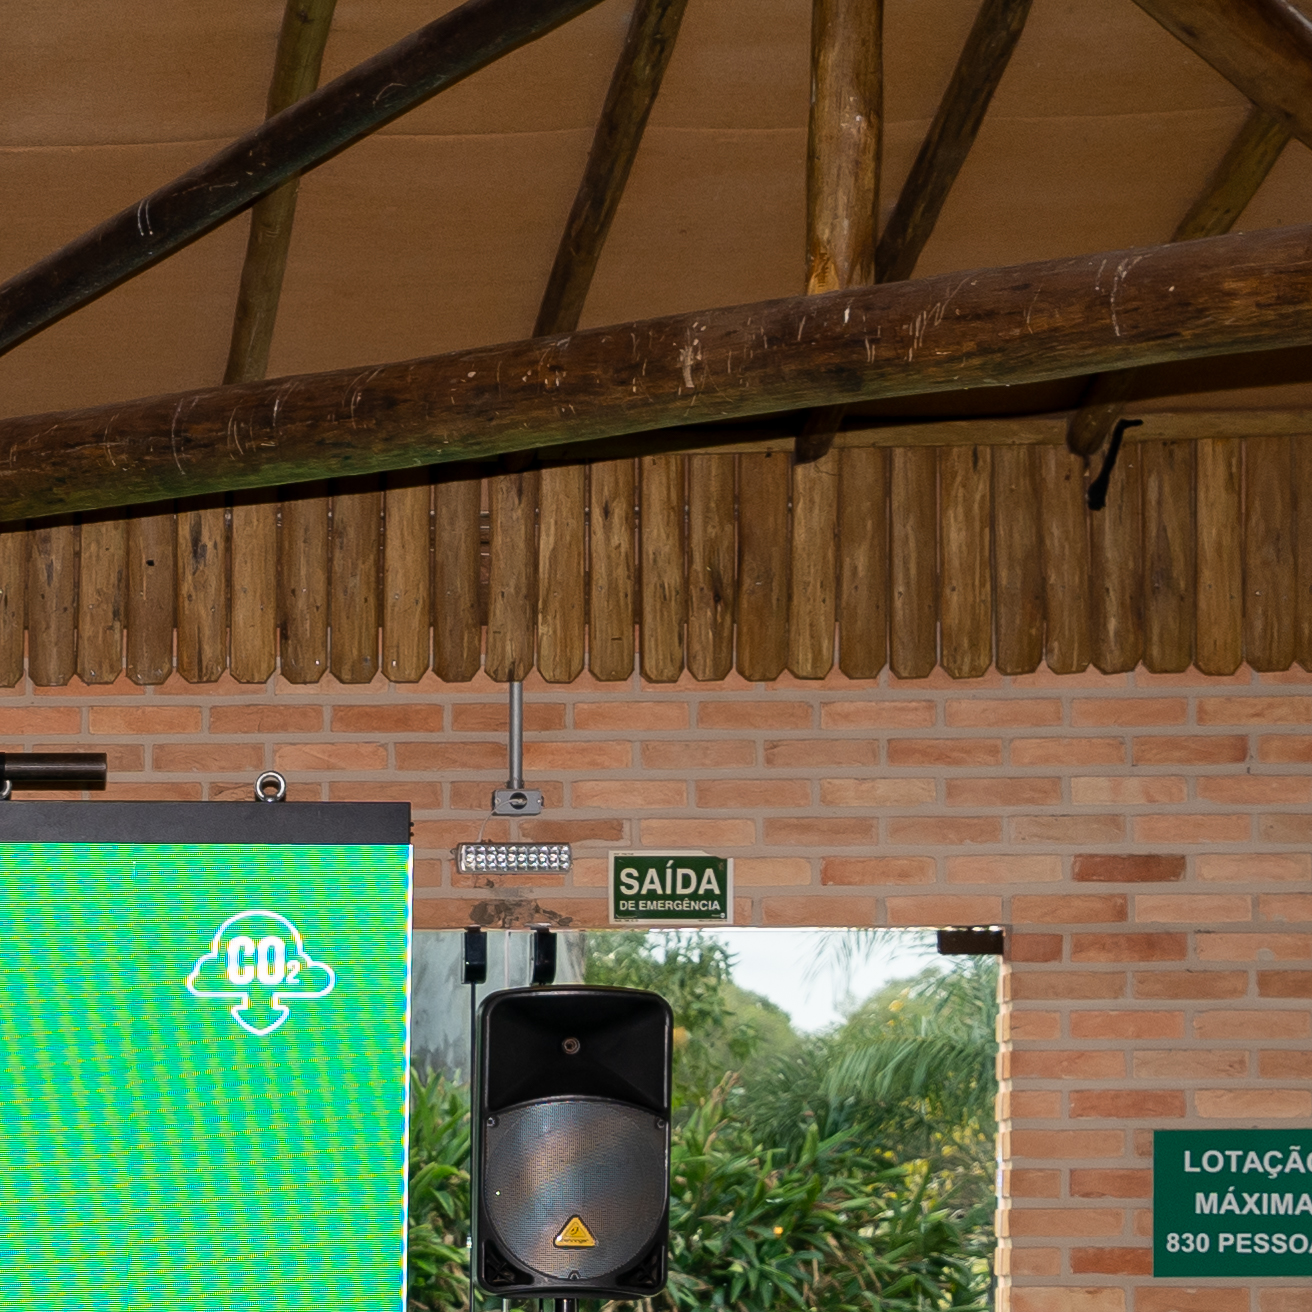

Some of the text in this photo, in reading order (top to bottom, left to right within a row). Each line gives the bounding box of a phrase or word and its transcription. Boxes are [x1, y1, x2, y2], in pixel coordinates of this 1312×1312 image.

[619, 859, 721, 895] SAÍDA
[619, 897, 721, 911] DE EMERGÊNCIA
[1183, 1145, 1312, 1179] LOTAÇÃ
[1194, 1186, 1312, 1216] MÁXIMA
[1166, 1232, 1312, 1254] 830 PESSO
